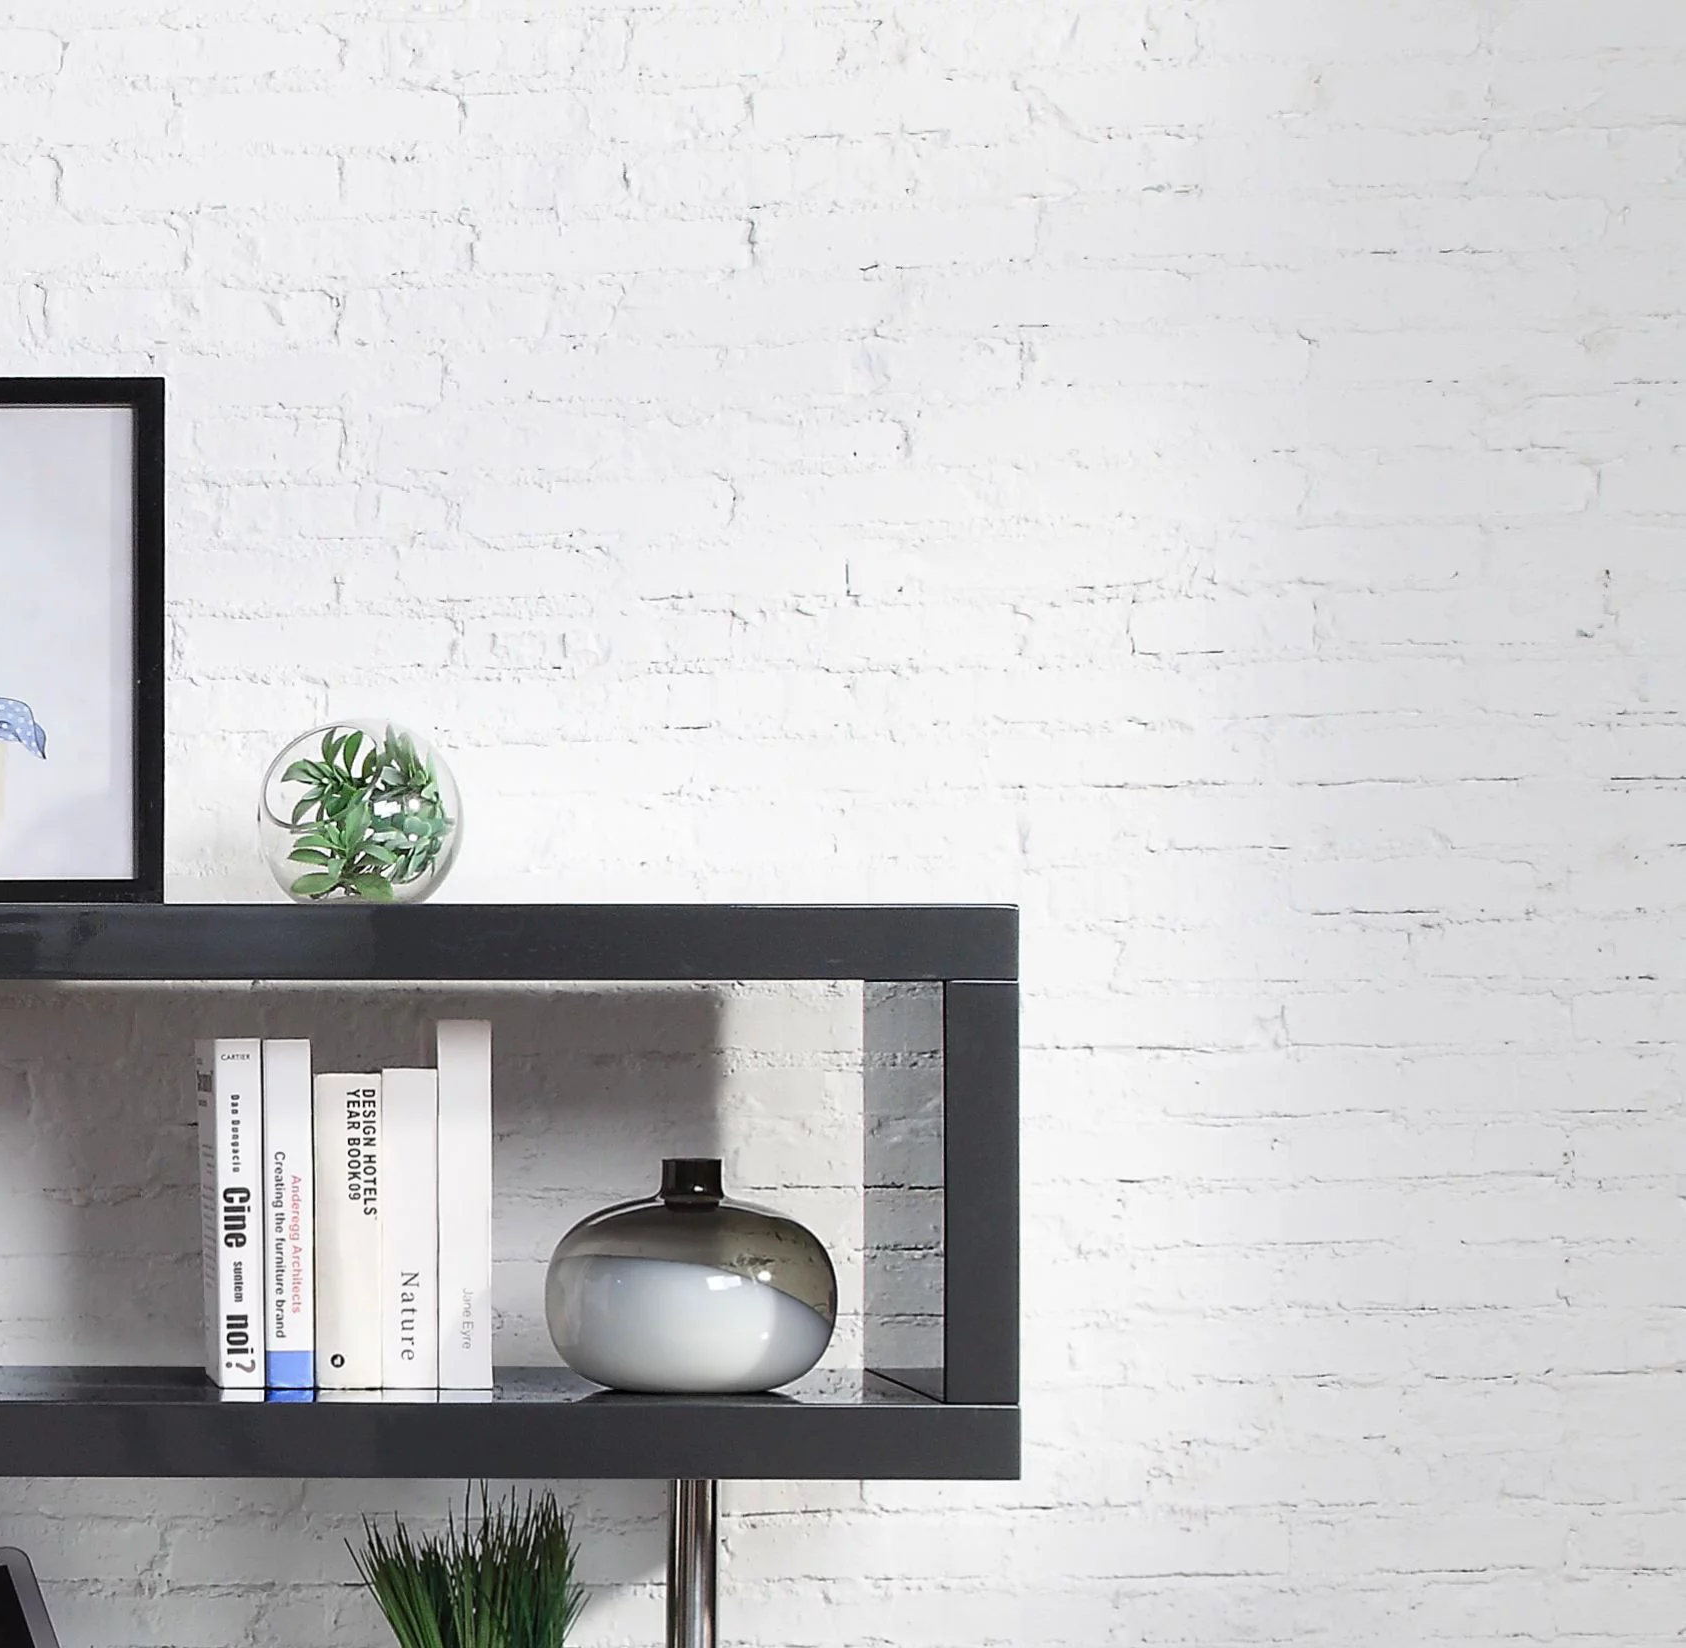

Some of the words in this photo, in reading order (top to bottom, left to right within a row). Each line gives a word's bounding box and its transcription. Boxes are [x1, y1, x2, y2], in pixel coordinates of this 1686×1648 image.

[346, 1088, 361, 1131] YEAR
[362, 1089, 376, 1147] DESIGN
[273, 1151, 286, 1208] Creating
[290, 1174, 302, 1241] Anderegg
[222, 1187, 251, 1248] Cine
[274, 1212, 286, 1233] the
[233, 1261, 244, 1303] suntem
[274, 1237, 287, 1295] furniture
[291, 1244, 304, 1314] Architects
[275, 1299, 287, 1338] brand
[400, 1271, 419, 1361] Nature
[462, 1287, 475, 1317] Jane
[460, 1321, 475, 1350] Eyre
